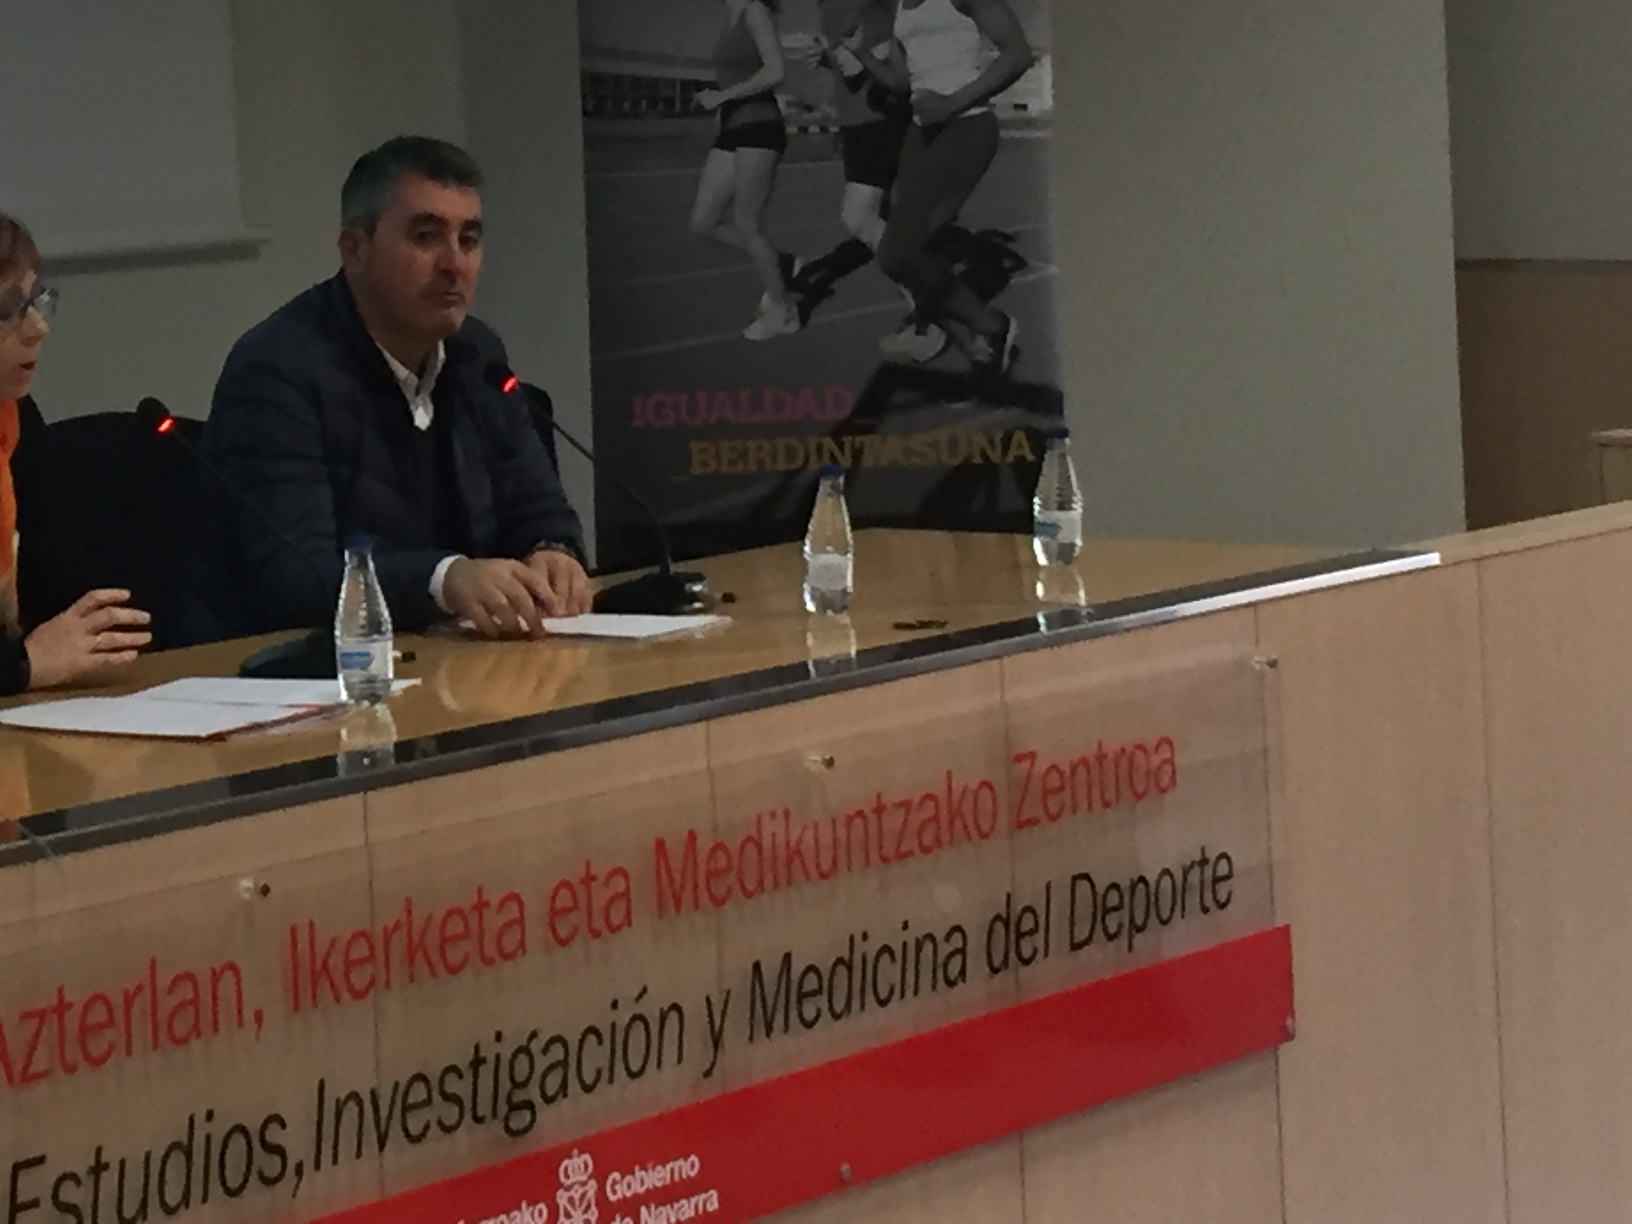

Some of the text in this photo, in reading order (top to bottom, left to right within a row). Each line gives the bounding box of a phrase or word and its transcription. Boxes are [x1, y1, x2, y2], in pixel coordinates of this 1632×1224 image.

[632, 387, 853, 426] IGUALDAD
[689, 431, 1035, 473] BERDINTASUNA
[289, 885, 528, 1014] Ikerketa
[547, 859, 633, 949] eta
[653, 770, 998, 920] Medikuntzako
[1013, 736, 1178, 831] Zentroa
[702, 988, 731, 1080] y
[747, 919, 968, 1045] Medicina
[985, 880, 1053, 979] del
[1069, 846, 1235, 955] Deporte
[605, 1154, 700, 1202] Gobierno
